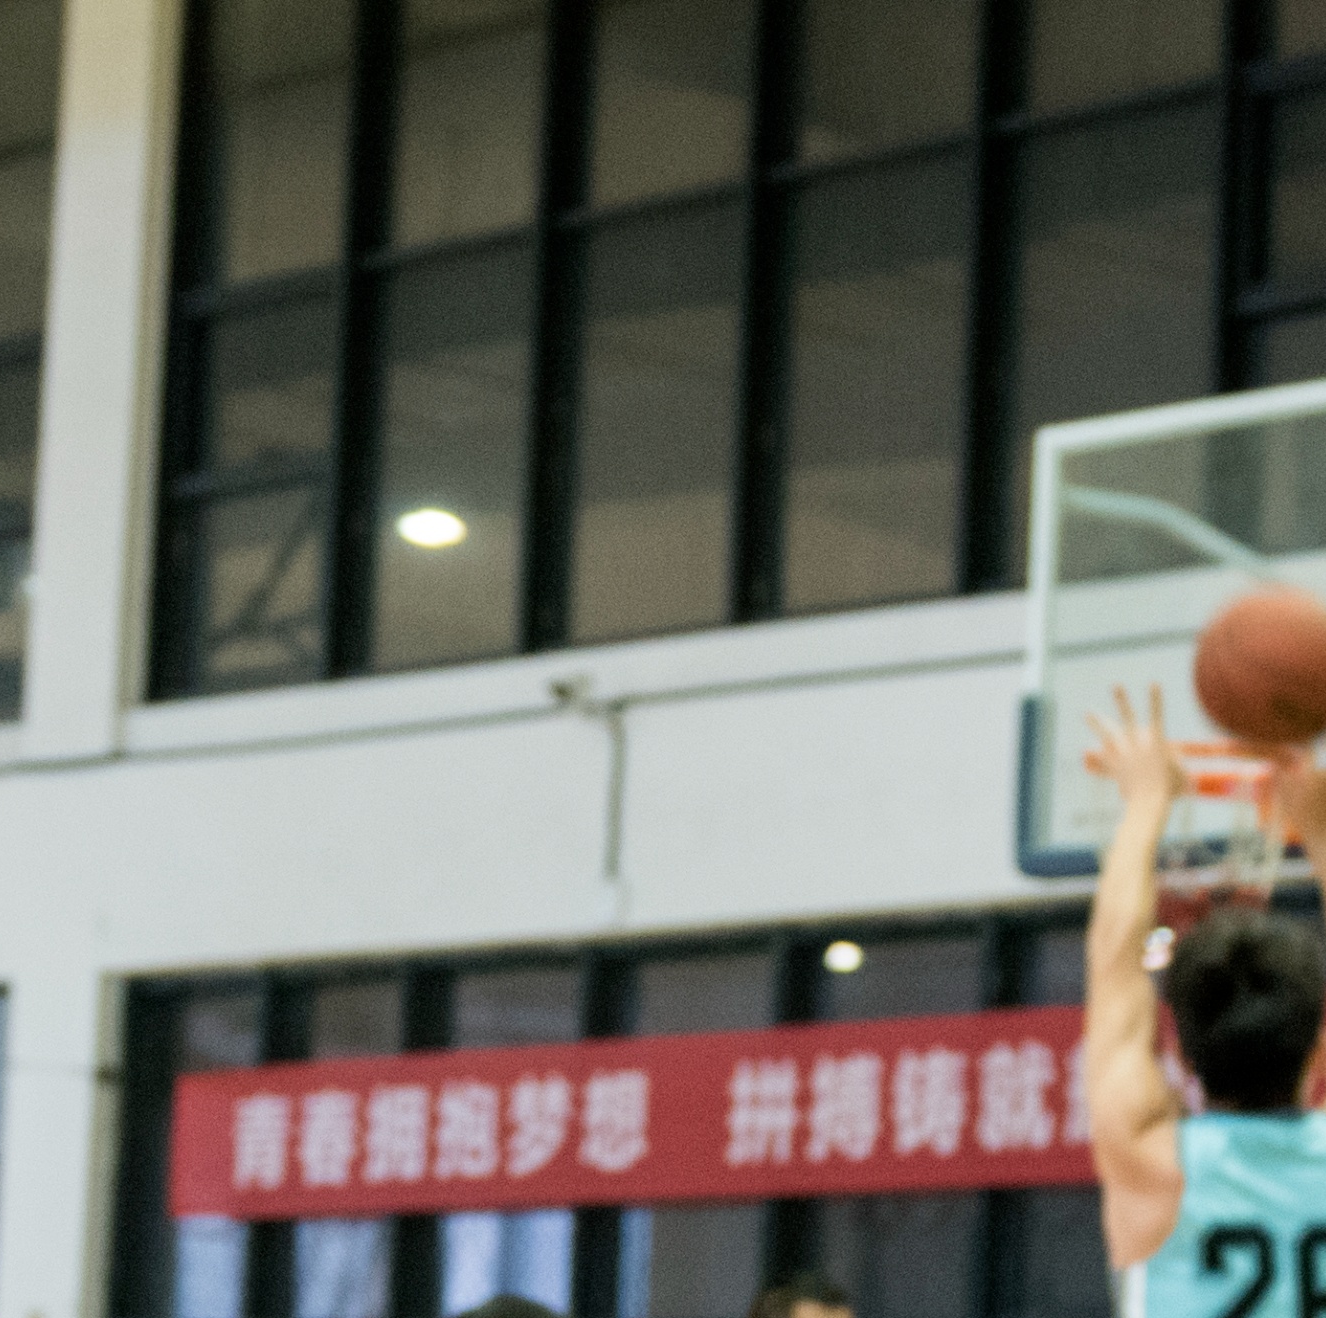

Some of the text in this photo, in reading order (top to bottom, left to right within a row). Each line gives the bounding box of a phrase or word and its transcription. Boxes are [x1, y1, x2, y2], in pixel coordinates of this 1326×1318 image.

[232, 1068, 653, 1190] 青春拥抱梦想
